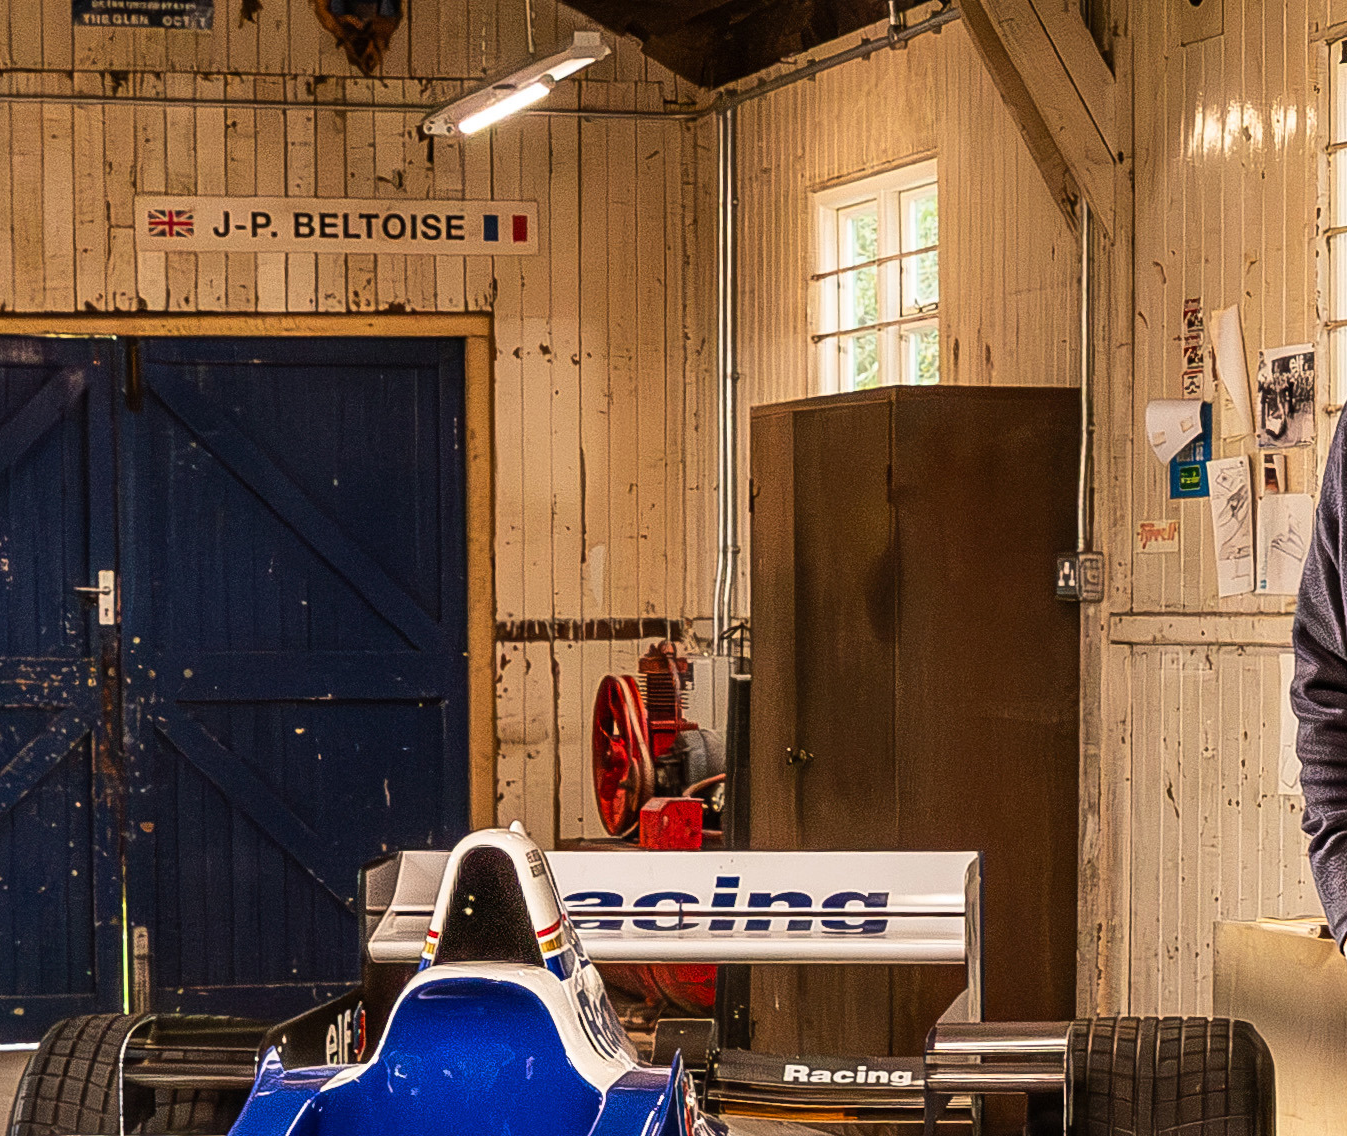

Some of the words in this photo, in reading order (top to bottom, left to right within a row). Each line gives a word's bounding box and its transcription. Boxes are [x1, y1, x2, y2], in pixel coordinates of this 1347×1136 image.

[213, 210, 278, 239] J-P.
[293, 212, 466, 241] BELTOISE
[562, 875, 891, 936] acing
[782, 1064, 913, 1087] Racing
